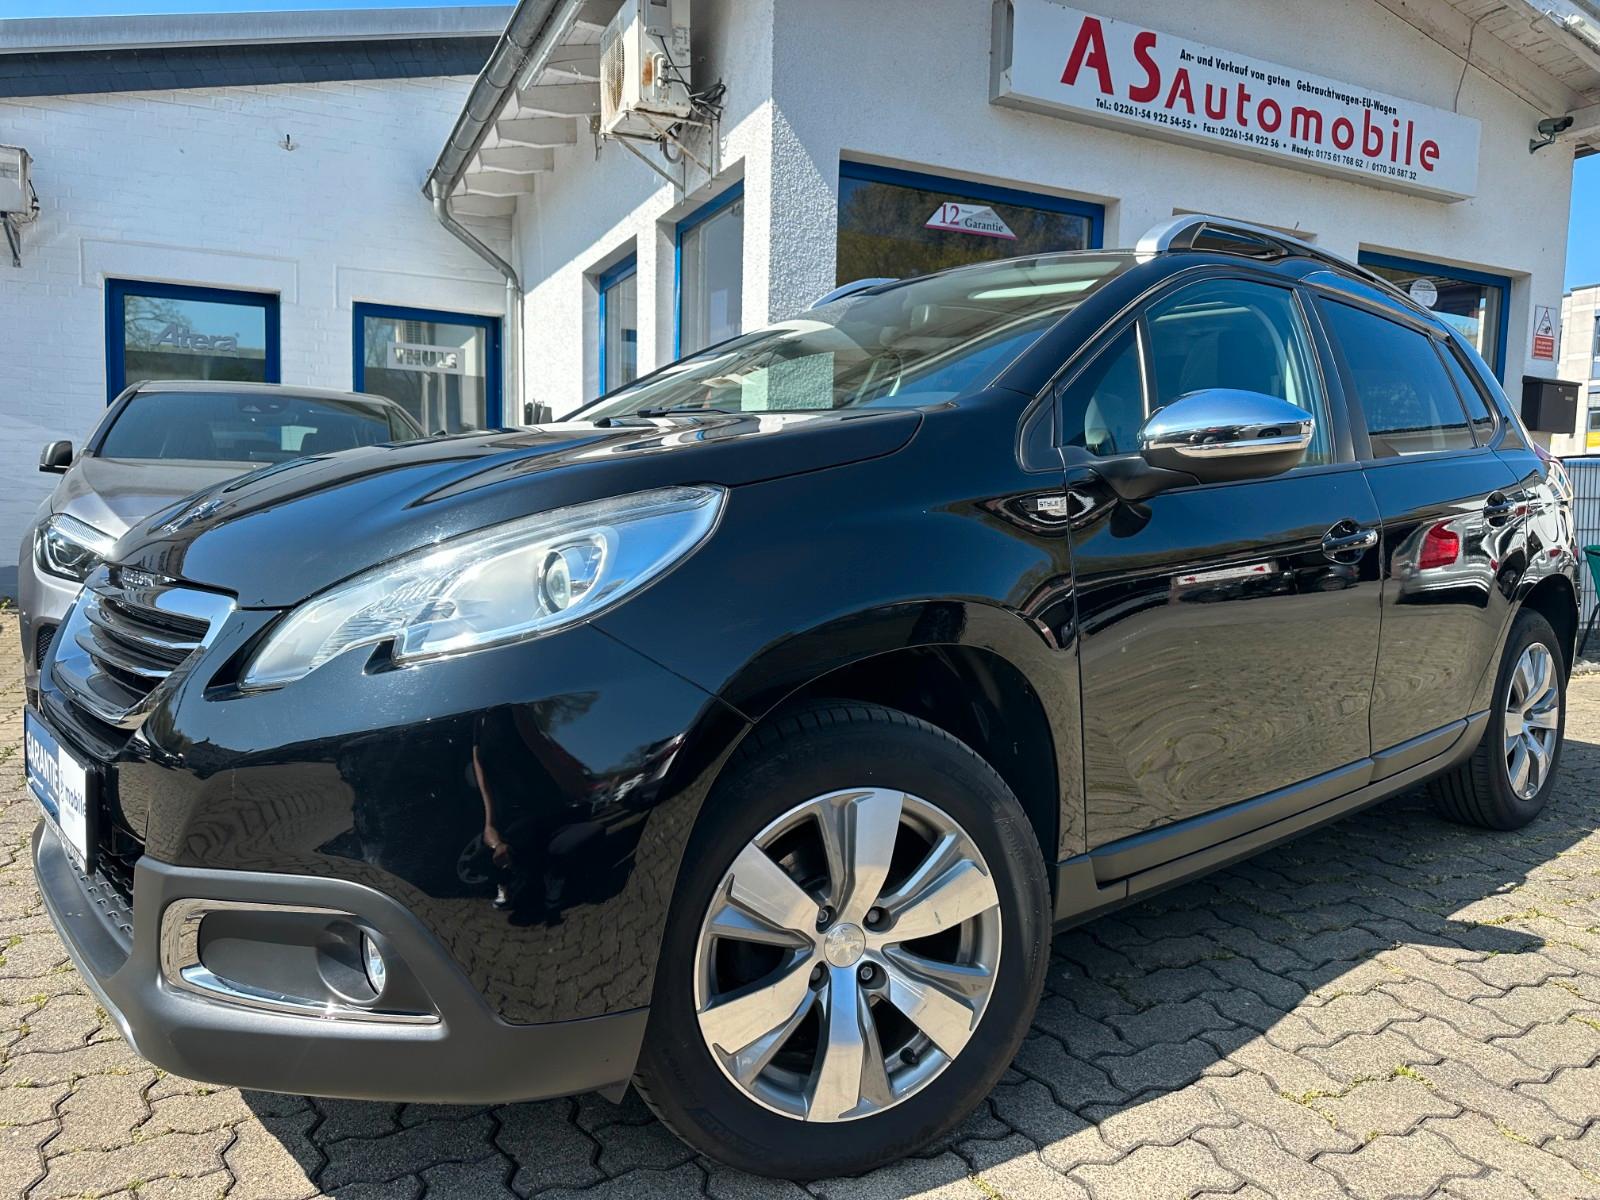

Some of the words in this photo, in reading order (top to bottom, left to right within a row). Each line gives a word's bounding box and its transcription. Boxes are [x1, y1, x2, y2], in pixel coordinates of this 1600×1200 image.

[1179, 49, 1195, 62] An-
[1197, 56, 1213, 67] und
[1215, 58, 1249, 77] Verkauf
[1250, 69, 1265, 81] von
[1267, 74, 1291, 88] guten
[1096, 98, 1112, 110] Tel.:
[1113, 102, 1151, 119] 02261-54
[1153, 112, 1168, 124] 922
[1170, 117, 1192, 129] 54-55
[1203, 122, 1219, 135] Fax:
[1220, 126, 1254, 142] 02261-54
[1255, 134, 1269, 146] 922
[1270, 138, 1279, 148] 56
[1315, 149, 1332, 161] 0175
[1371, 162, 1387, 174] 0170
[940, 203, 960, 225] 12
[964, 217, 1004, 233] Garantie
[150, 323, 238, 352] Atera
[393, 347, 457, 368] THULE
